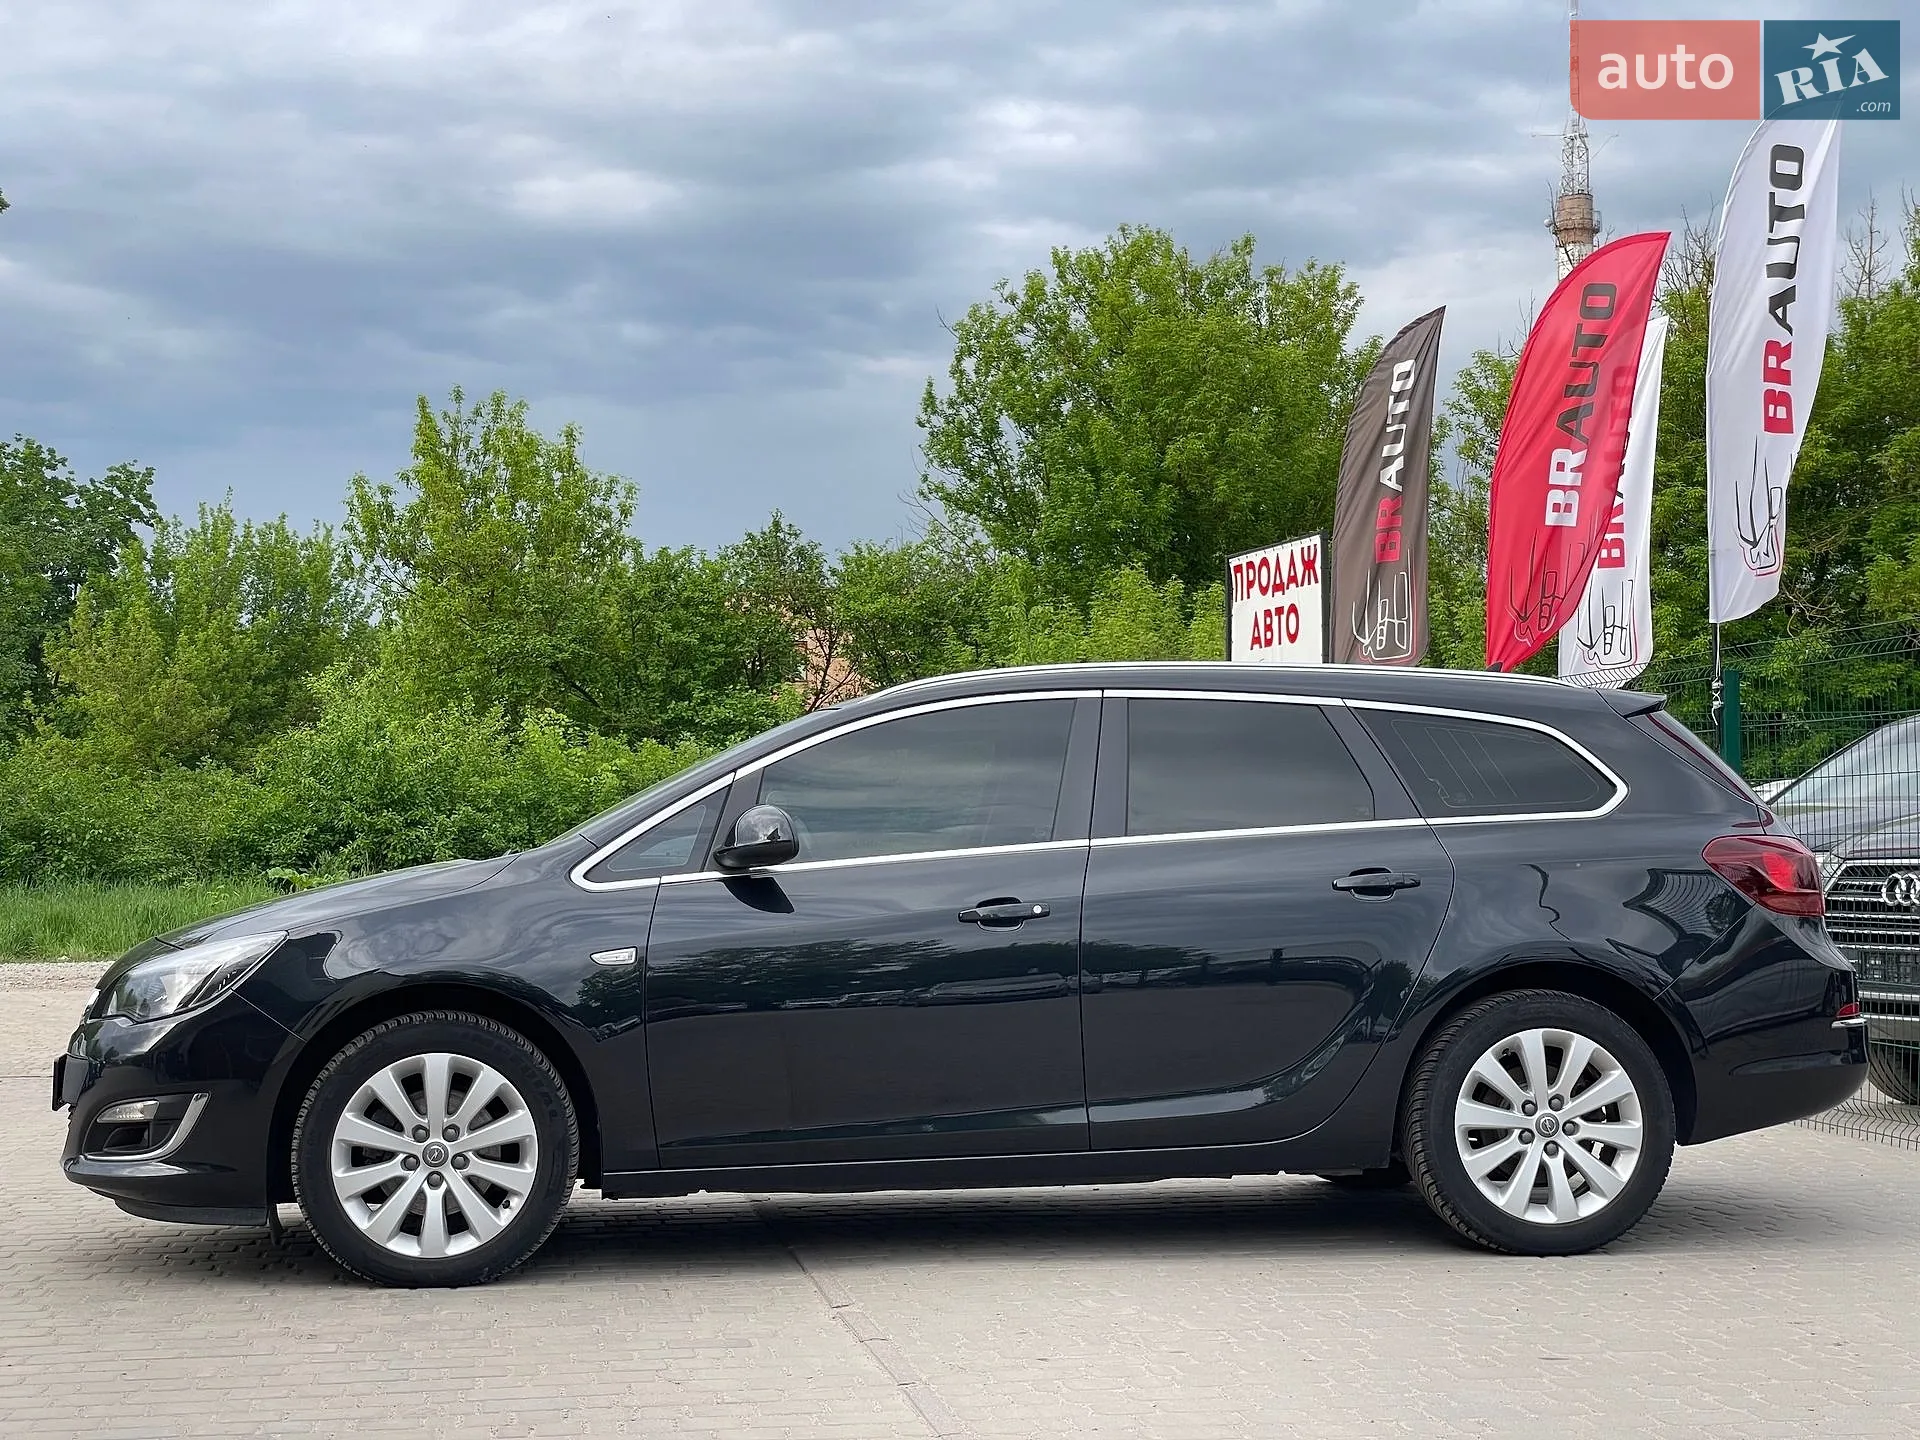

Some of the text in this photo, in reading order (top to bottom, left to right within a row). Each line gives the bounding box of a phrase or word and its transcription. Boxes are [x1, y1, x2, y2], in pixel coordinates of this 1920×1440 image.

[1763, 144, 1805, 434] BRAUTO
[1375, 359, 1416, 563] BRAUTO
[1544, 282, 1617, 528] BRAUTO
[1233, 543, 1319, 602] ПРОДАЖ
[1250, 603, 1300, 651] АВТО
